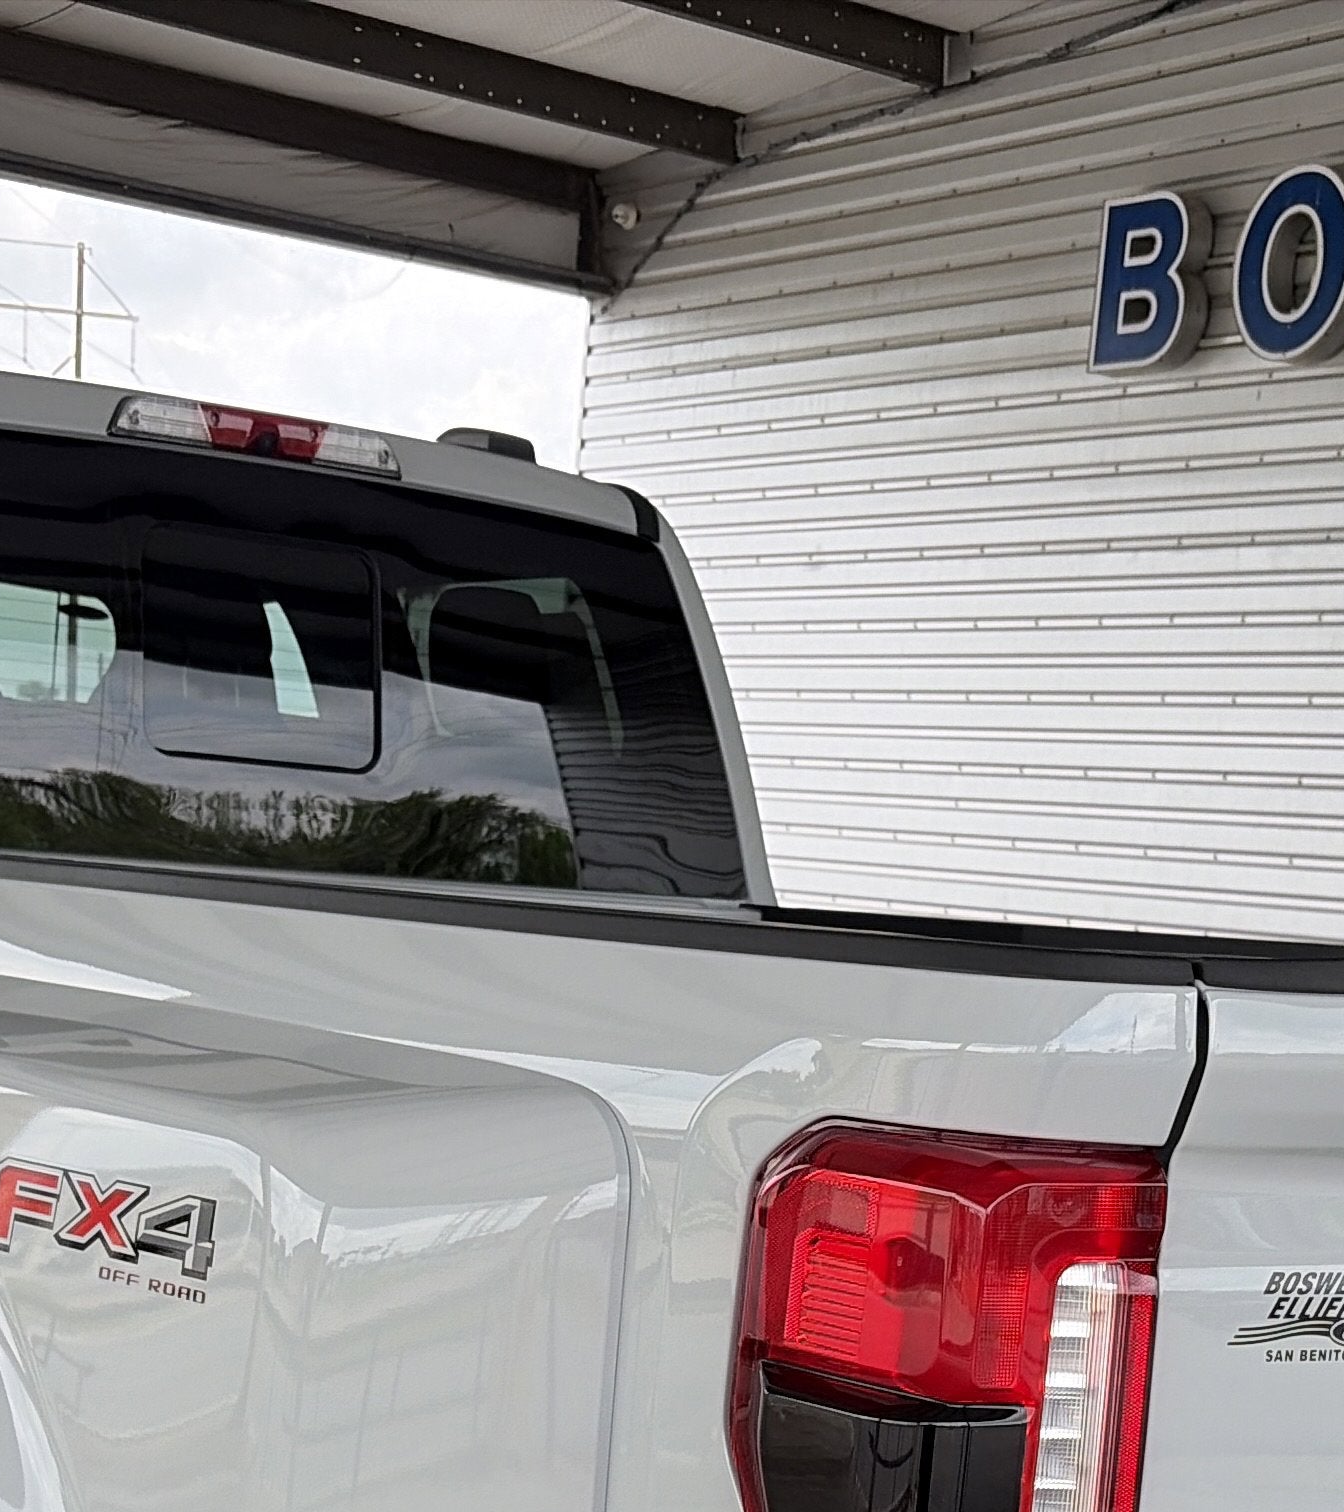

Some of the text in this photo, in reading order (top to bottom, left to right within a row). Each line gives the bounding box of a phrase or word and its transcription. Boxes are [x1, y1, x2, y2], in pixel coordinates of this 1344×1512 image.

[98, 1265, 206, 1304] OFF ROAD
[1265, 1349, 1294, 1363] SAN
